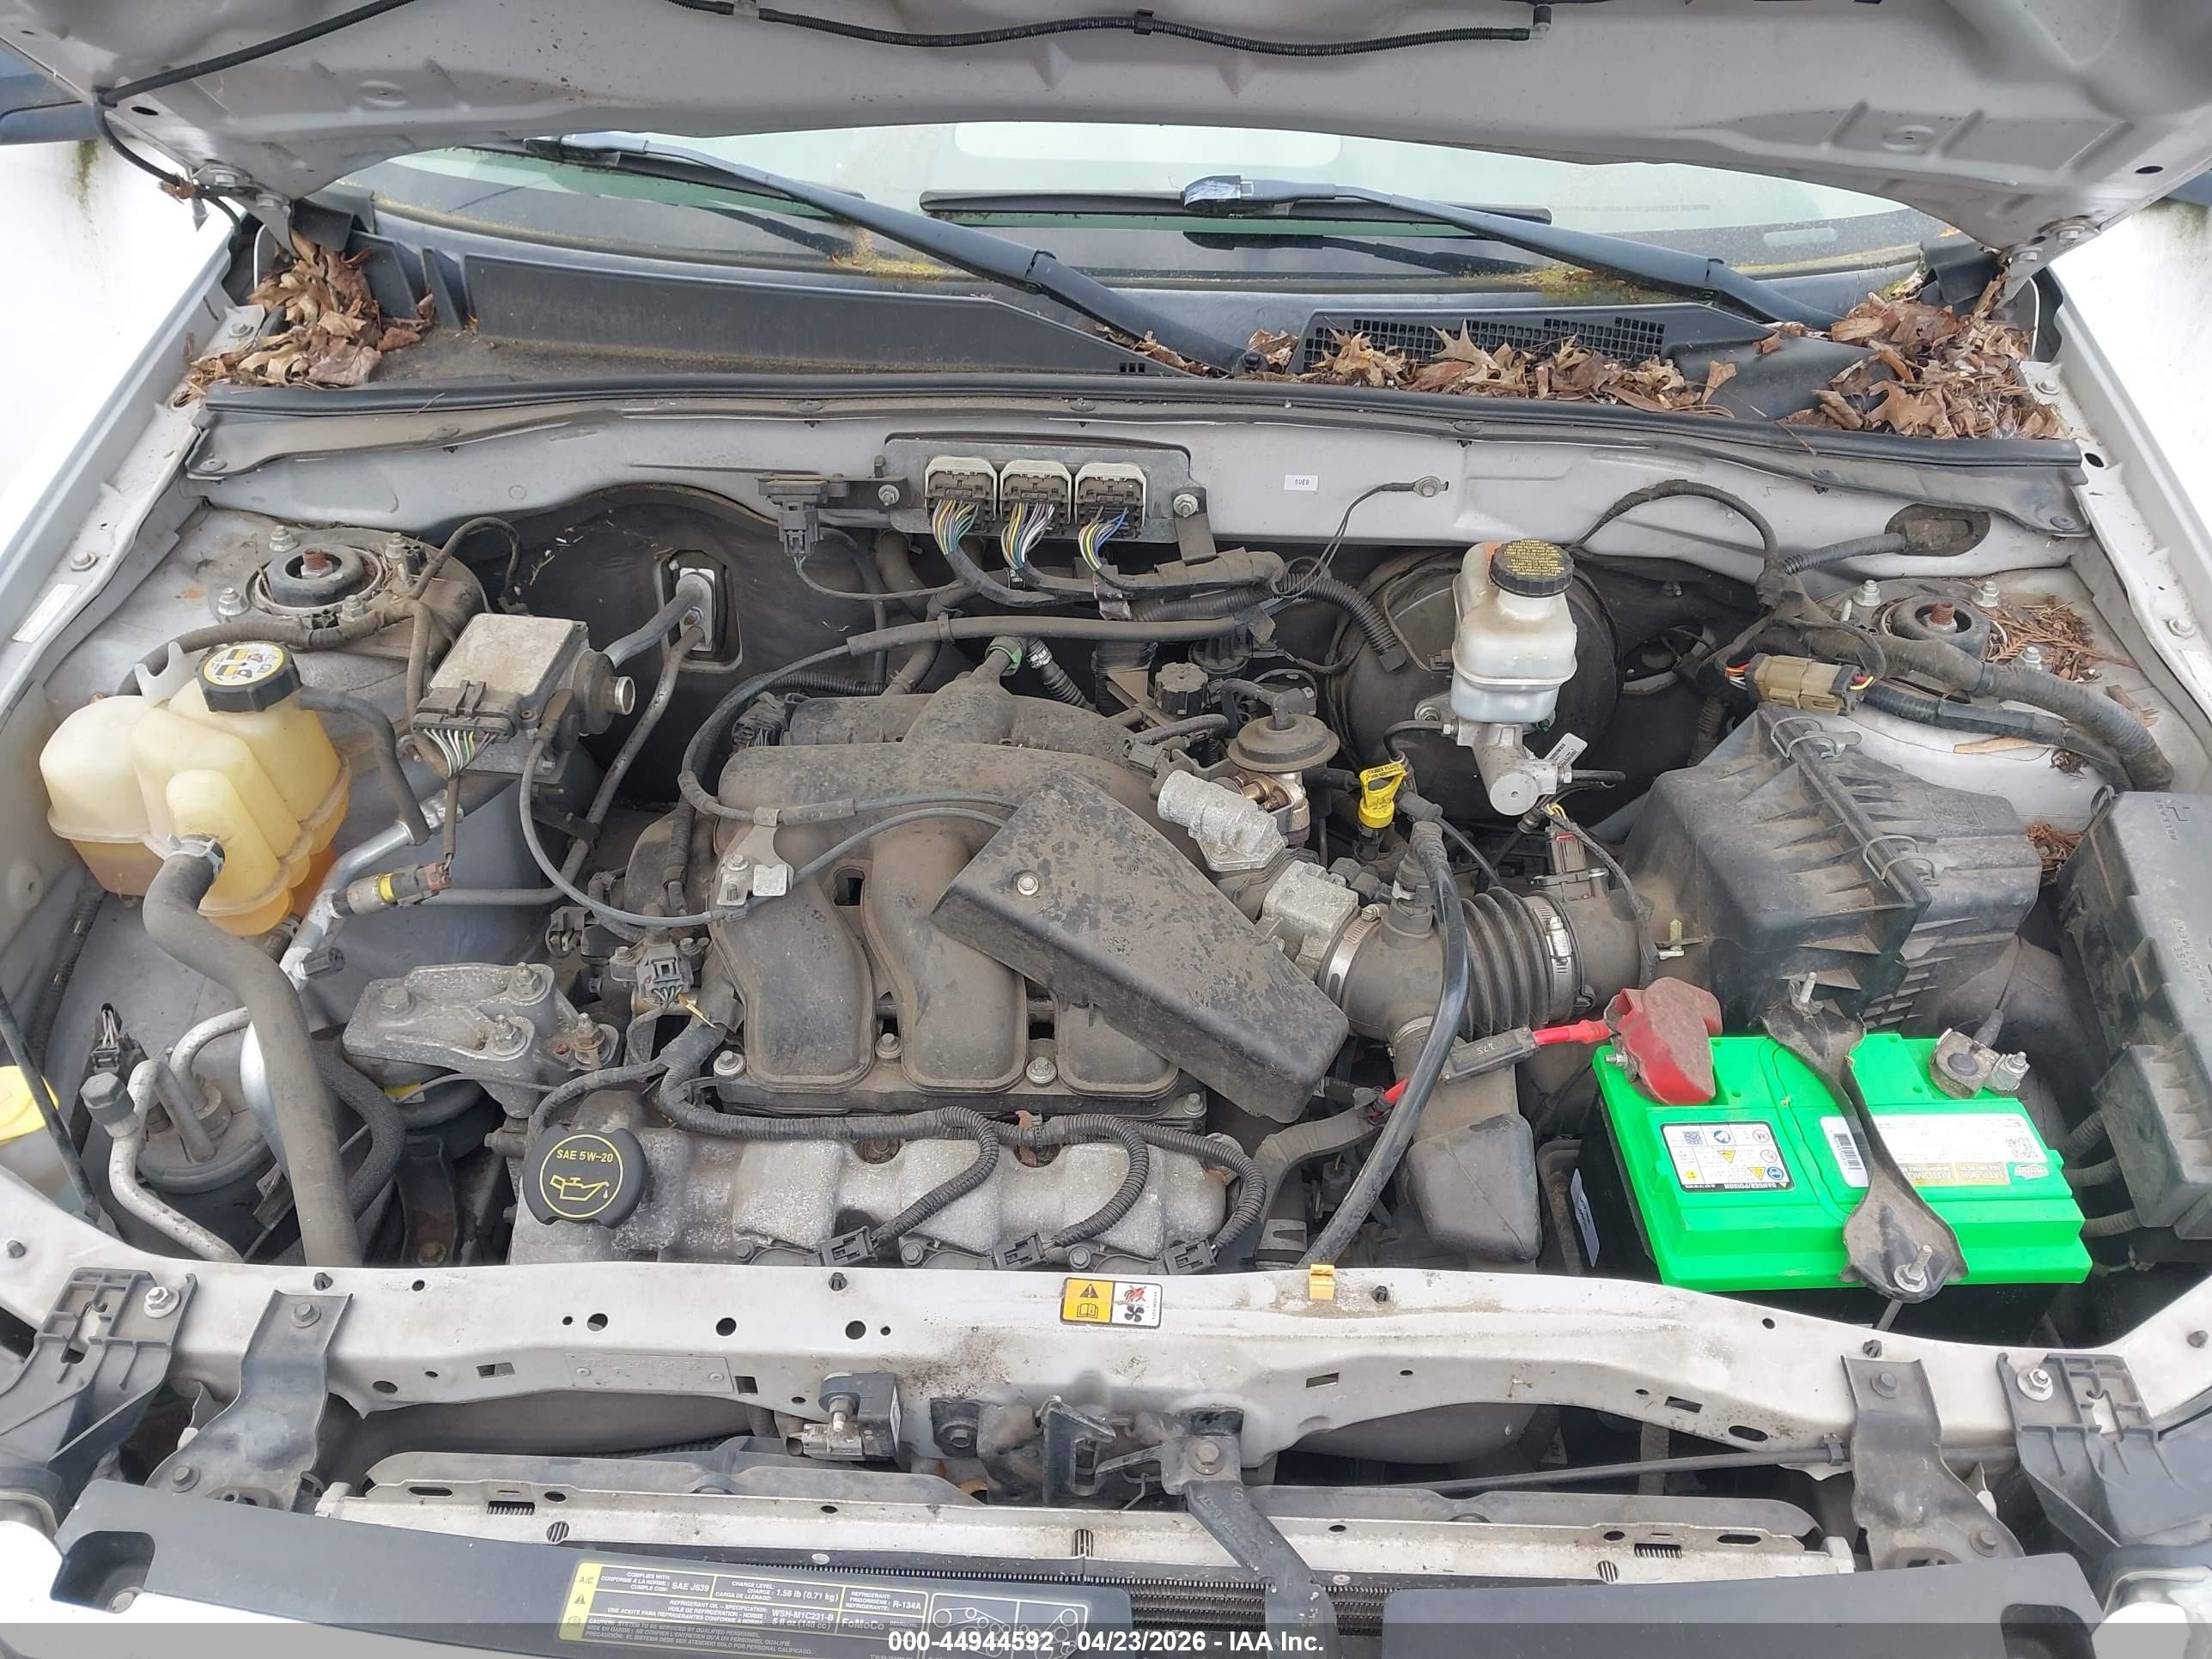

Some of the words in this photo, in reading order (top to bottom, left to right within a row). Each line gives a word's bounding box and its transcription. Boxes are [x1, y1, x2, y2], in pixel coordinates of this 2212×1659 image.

[556, 1149, 577, 1160] SAE
[579, 1151, 614, 1163] 5W-20
[672, 1582, 689, 1590] SAE
[690, 1583, 709, 1592] J639
[776, 1589, 793, 1597] 1.56
[803, 1591, 823, 1600] (0.71
[825, 1593, 839, 1602] kg)
[893, 1600, 921, 1610] R-134A
[772, 1608, 834, 1621] WSH-M1C231-B
[817, 1622, 831, 1631] cc)
[842, 1618, 884, 1631] FoMoCo
